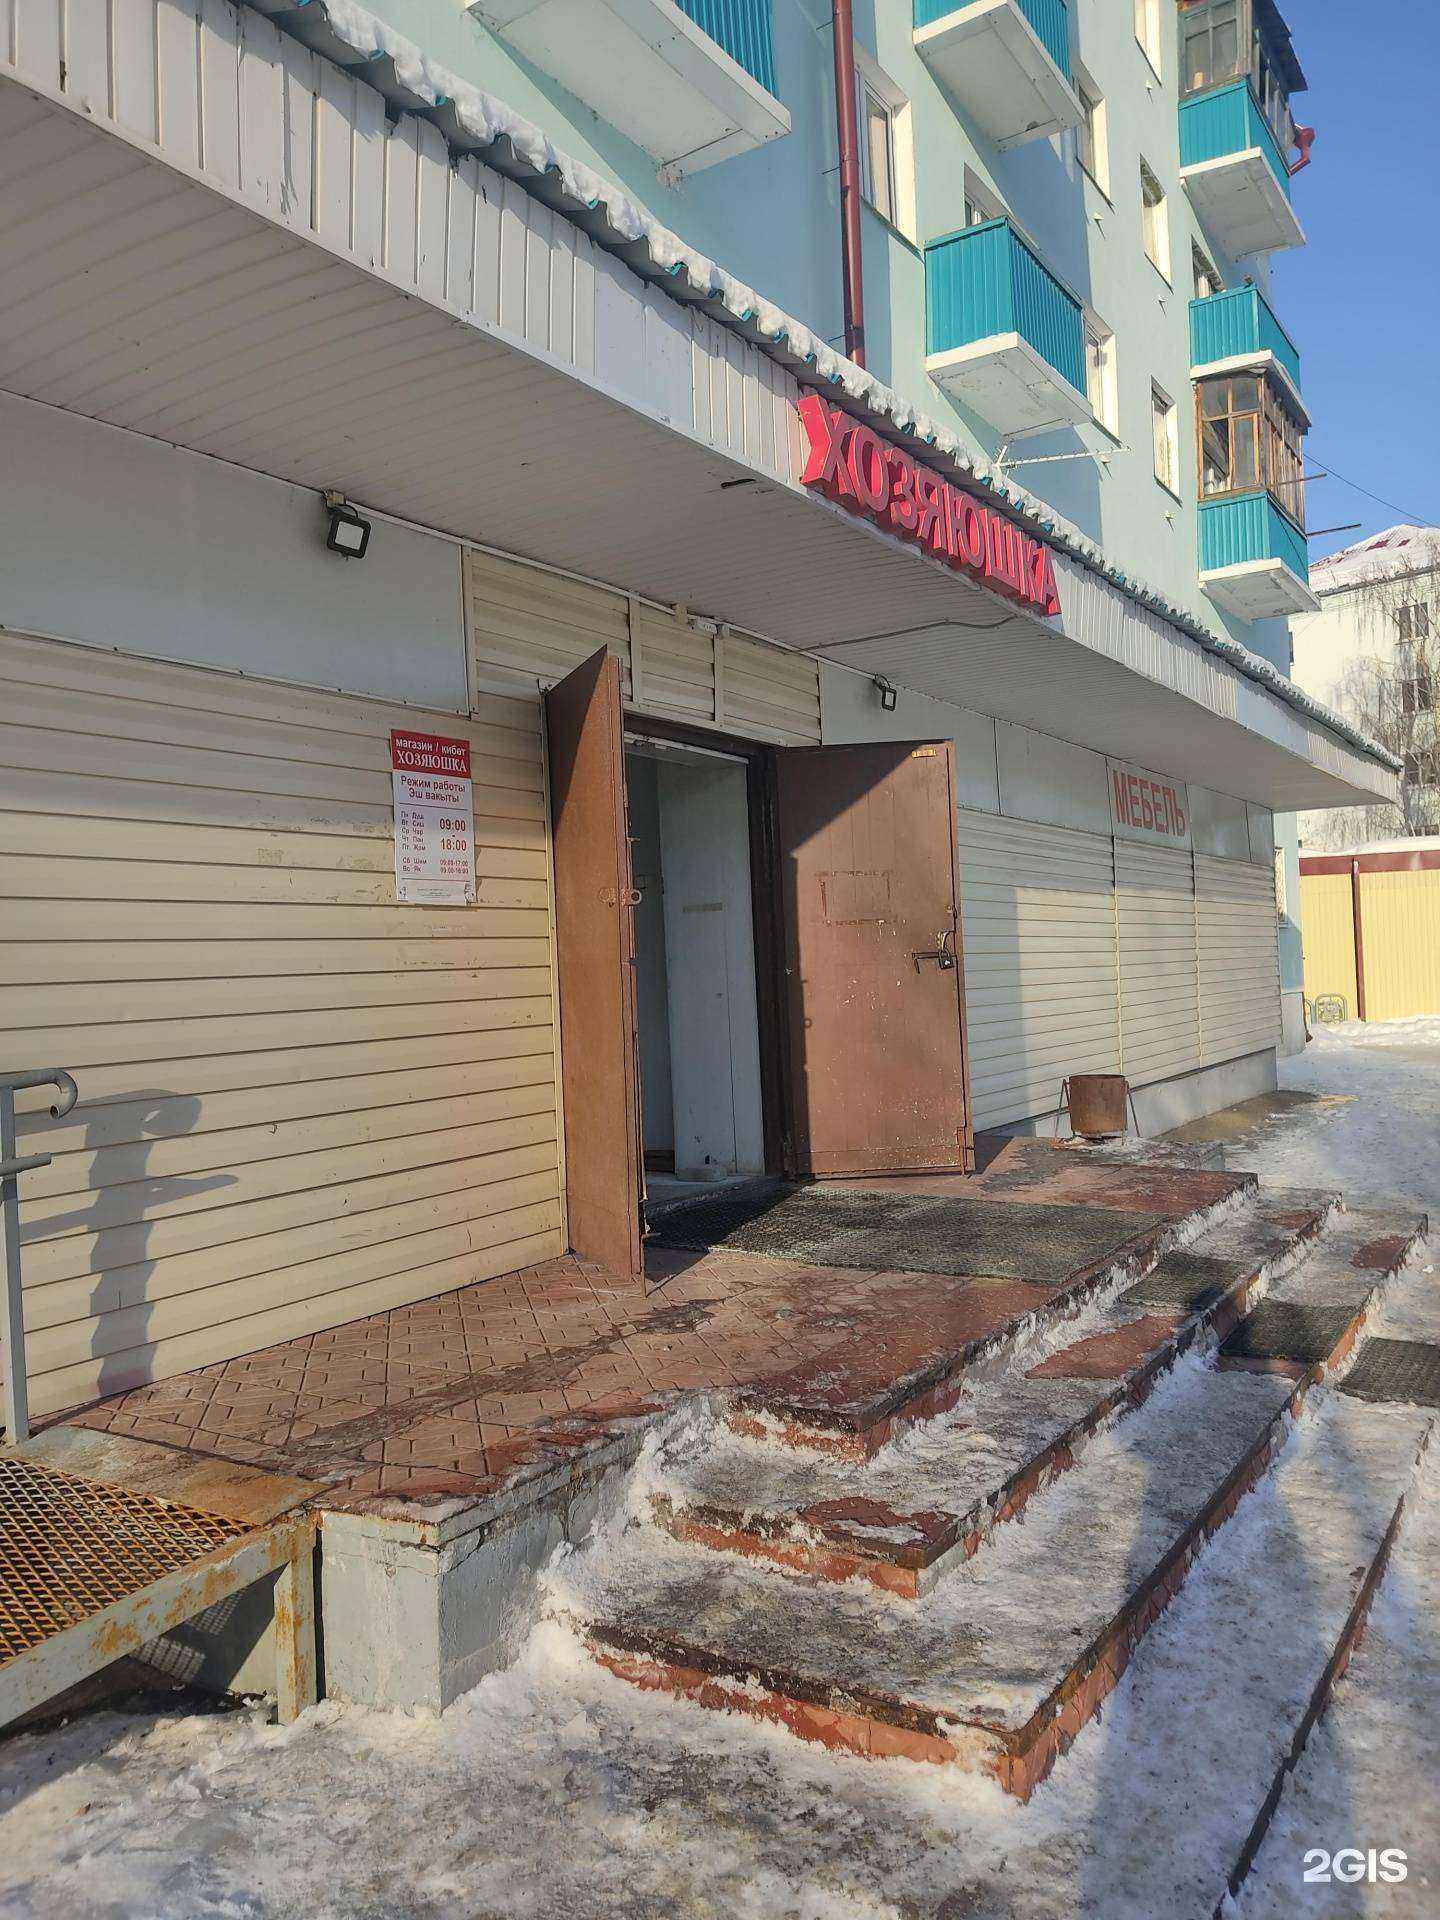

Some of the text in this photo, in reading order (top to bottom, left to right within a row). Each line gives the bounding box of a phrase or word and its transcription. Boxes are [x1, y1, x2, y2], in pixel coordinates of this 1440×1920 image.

[797, 394, 1061, 615] ХОЗЯЮШКА
[396, 750, 467, 773] ХОЗЯЮШКА
[401, 776, 465, 792] Режим работы
[409, 787, 459, 803] Эш вакыты
[1112, 767, 1186, 837] МЕБЕЛЬ
[439, 818, 466, 831] 09:00
[441, 837, 467, 851] 18:00
